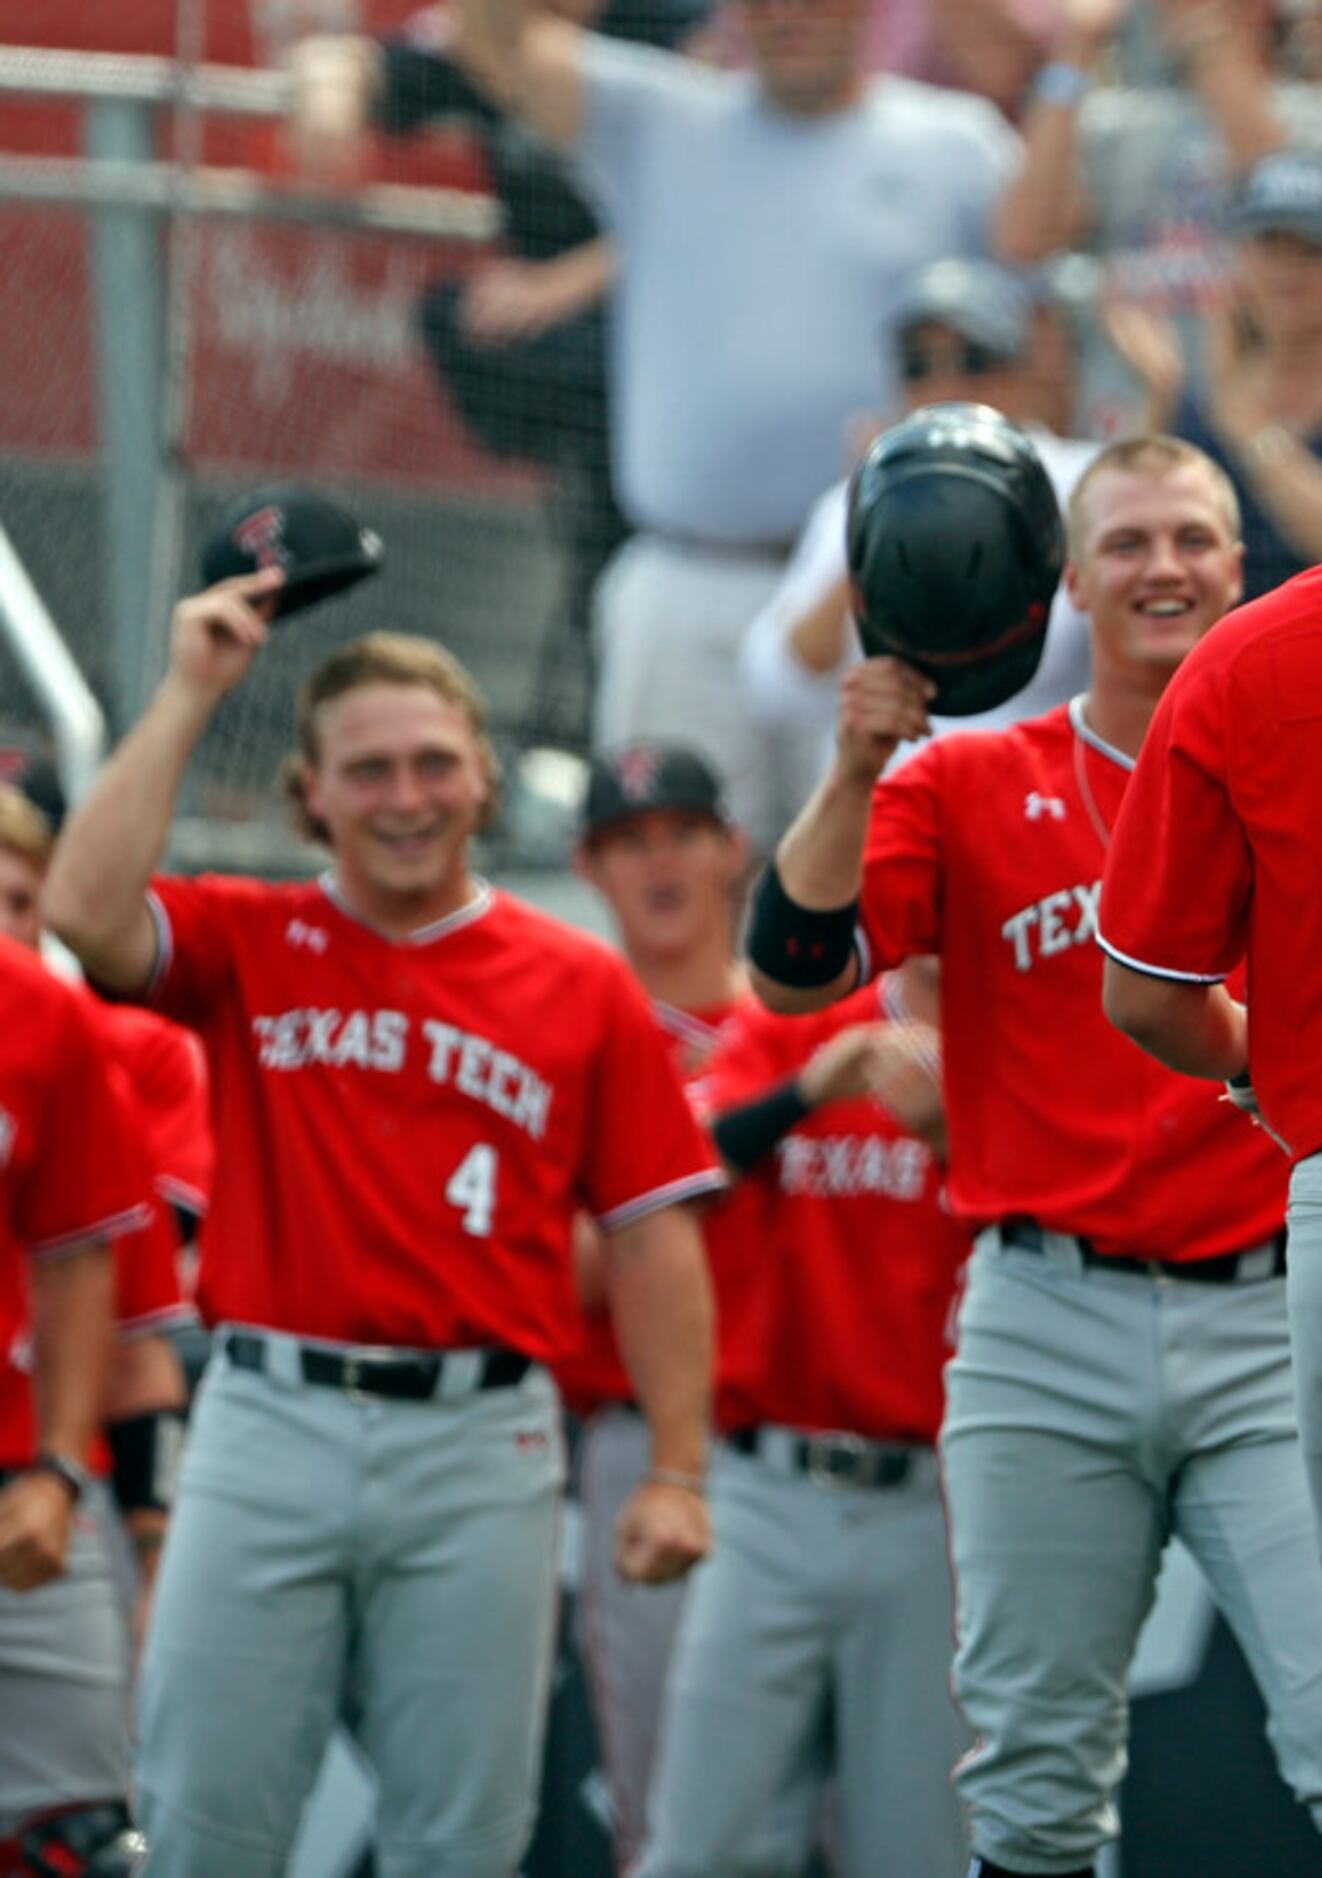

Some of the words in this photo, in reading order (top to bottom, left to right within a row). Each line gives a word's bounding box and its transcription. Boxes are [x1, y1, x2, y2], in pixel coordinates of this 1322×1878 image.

[252, 1006, 408, 1072] TEXAS
[421, 1017, 552, 1142] TECH
[445, 1141, 498, 1238] 4
